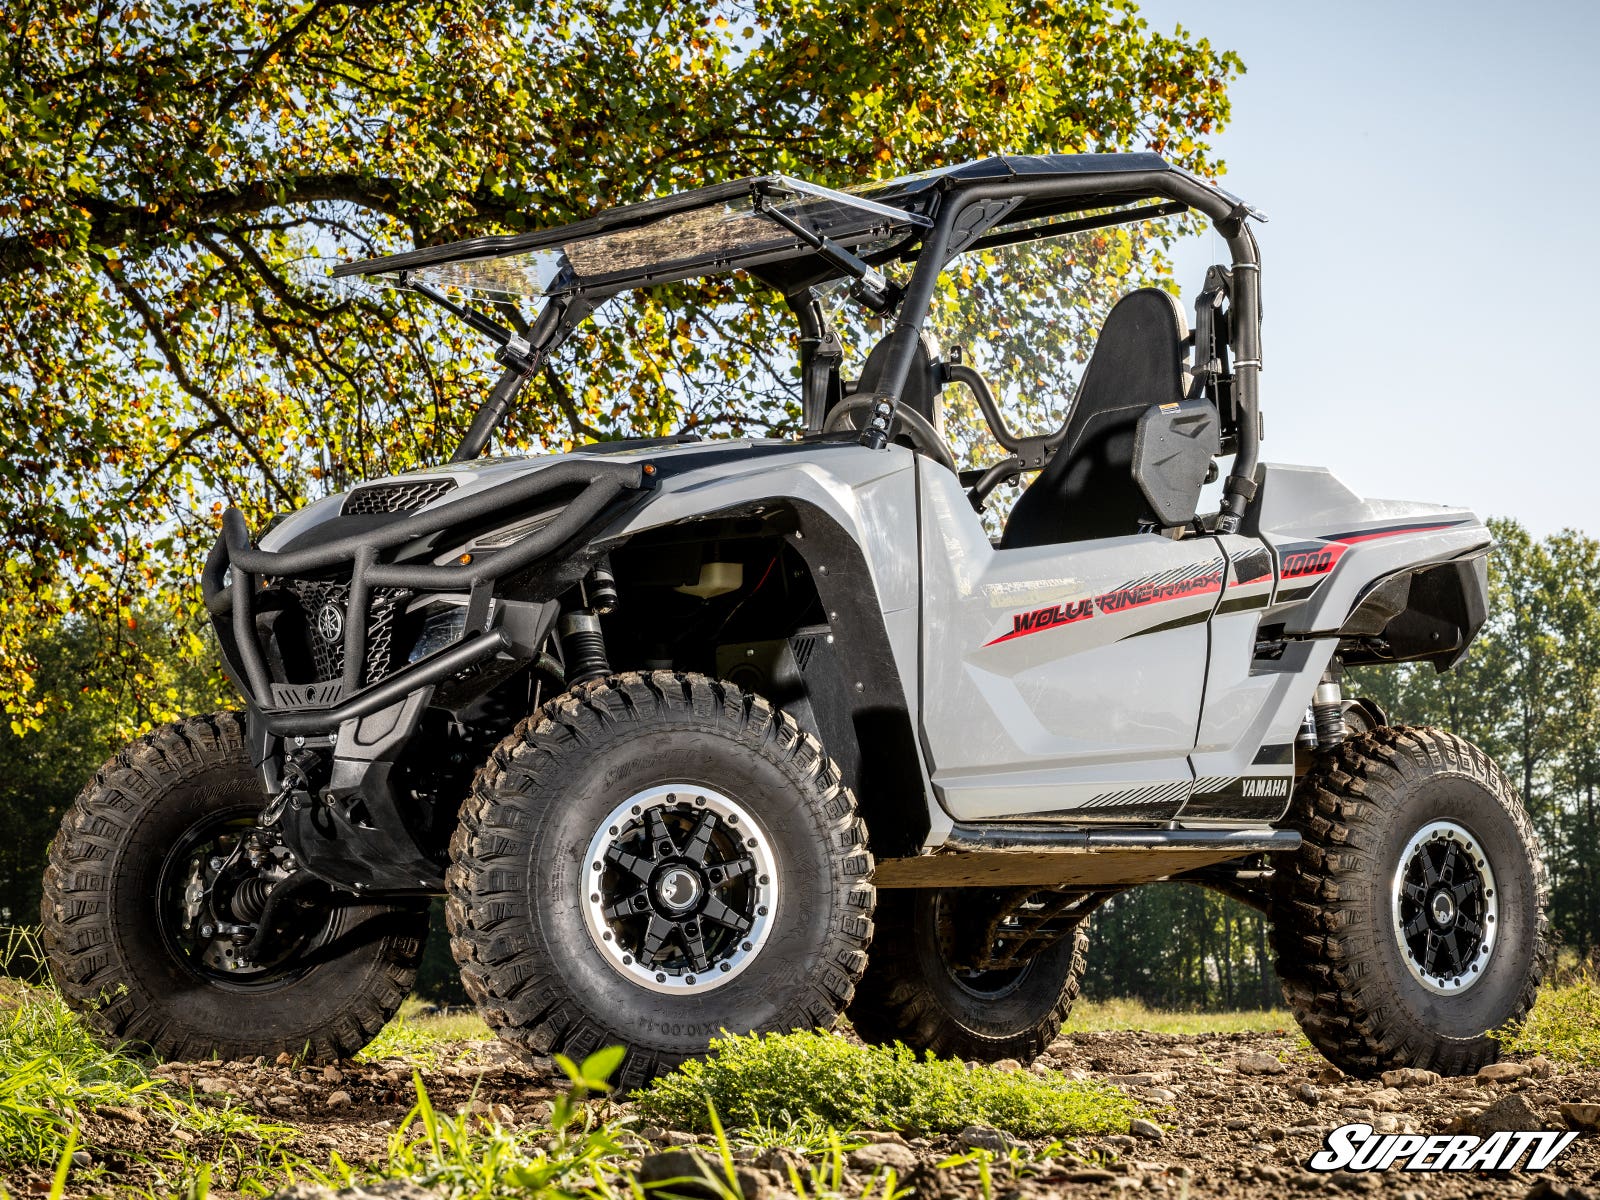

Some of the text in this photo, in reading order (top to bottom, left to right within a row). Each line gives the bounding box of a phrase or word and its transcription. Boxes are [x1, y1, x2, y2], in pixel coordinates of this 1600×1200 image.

[1283, 552, 1333, 577] 1000
[1013, 584, 1154, 633] WOLVERINE
[1242, 779, 1288, 797] YAMAHA
